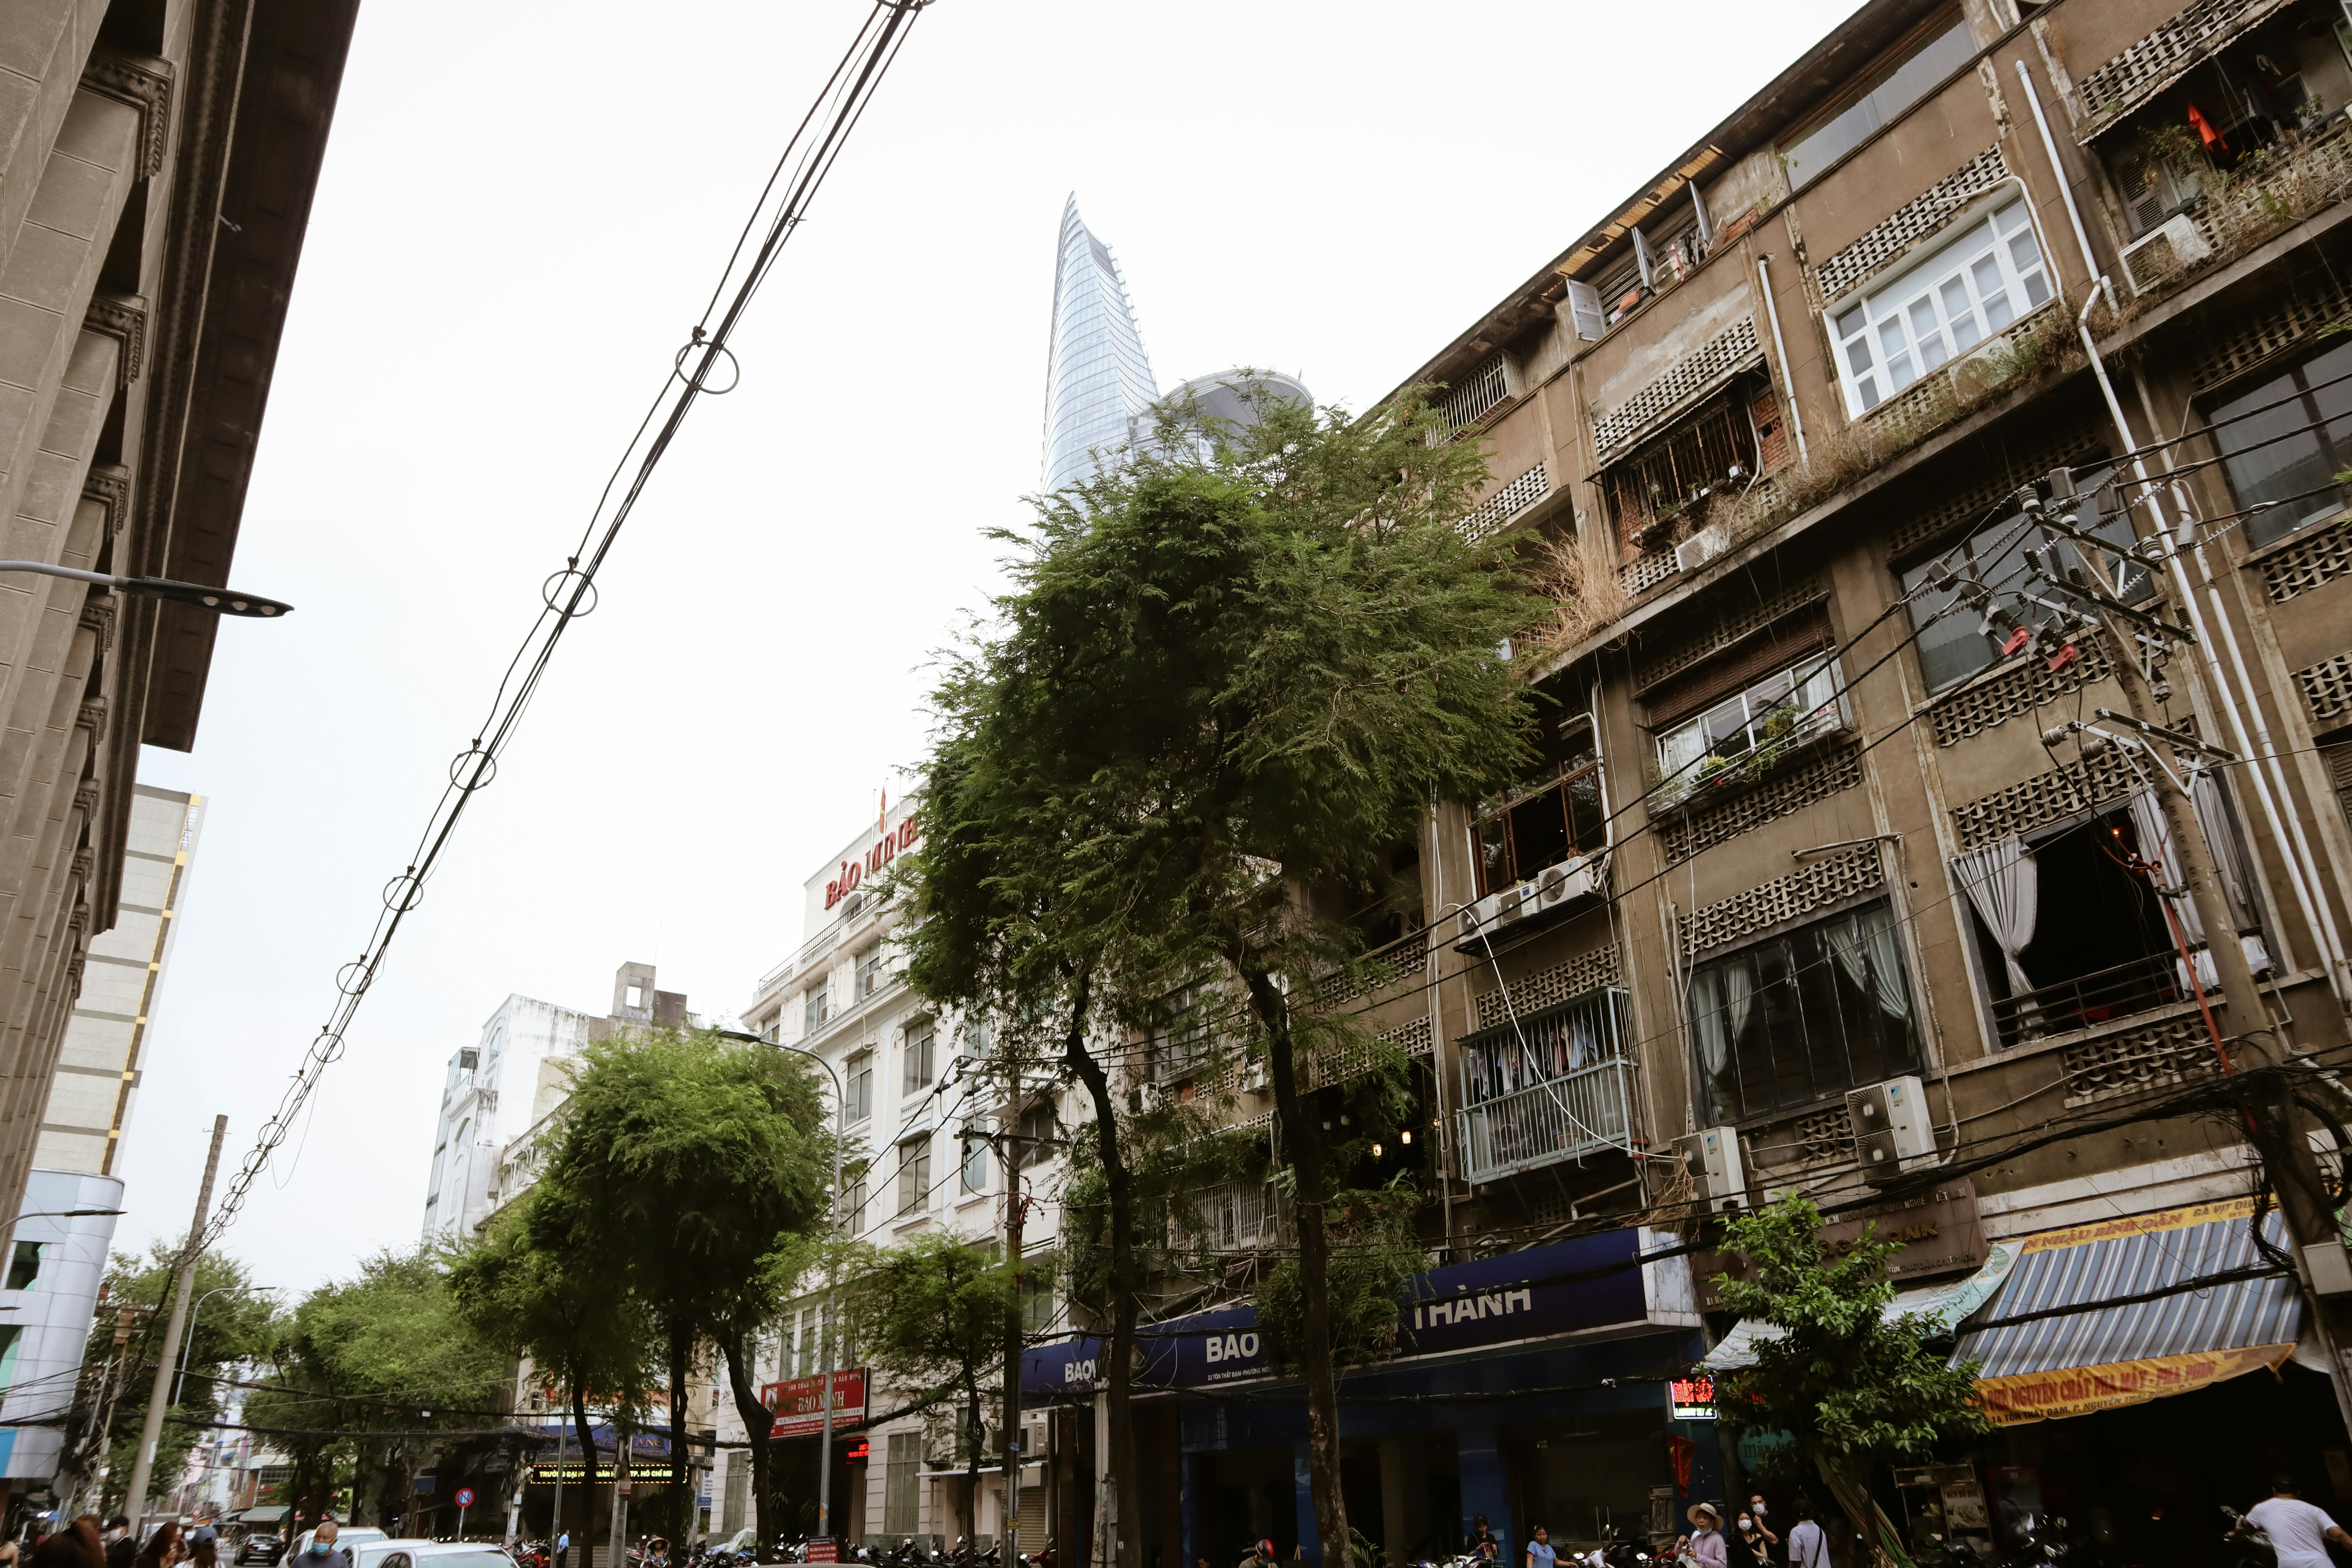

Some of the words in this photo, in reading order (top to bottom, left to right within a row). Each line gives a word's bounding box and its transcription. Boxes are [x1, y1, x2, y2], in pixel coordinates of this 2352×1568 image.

[824, 860, 861, 910] BẢO
[2043, 1229, 2092, 1246] NHẬU
[2094, 1222, 2137, 1237] BÌNH
[2141, 1213, 2184, 1229] DÂN
[1887, 1265, 1900, 1273] TÔN
[839, 1374, 847, 1383] BẢO
[1221, 1370, 1231, 1378] THẤT
[1673, 1379, 1694, 1407] GIẶT
[2011, 1377, 2058, 1408] NGUYÊN
[2060, 1368, 2091, 1401] CHẤT
[798, 1390, 816, 1412] BẢO
[818, 1391, 845, 1409] MNH
[651, 1469, 662, 1477] CHÍ
[1118, 1541, 1124, 1550] 10
